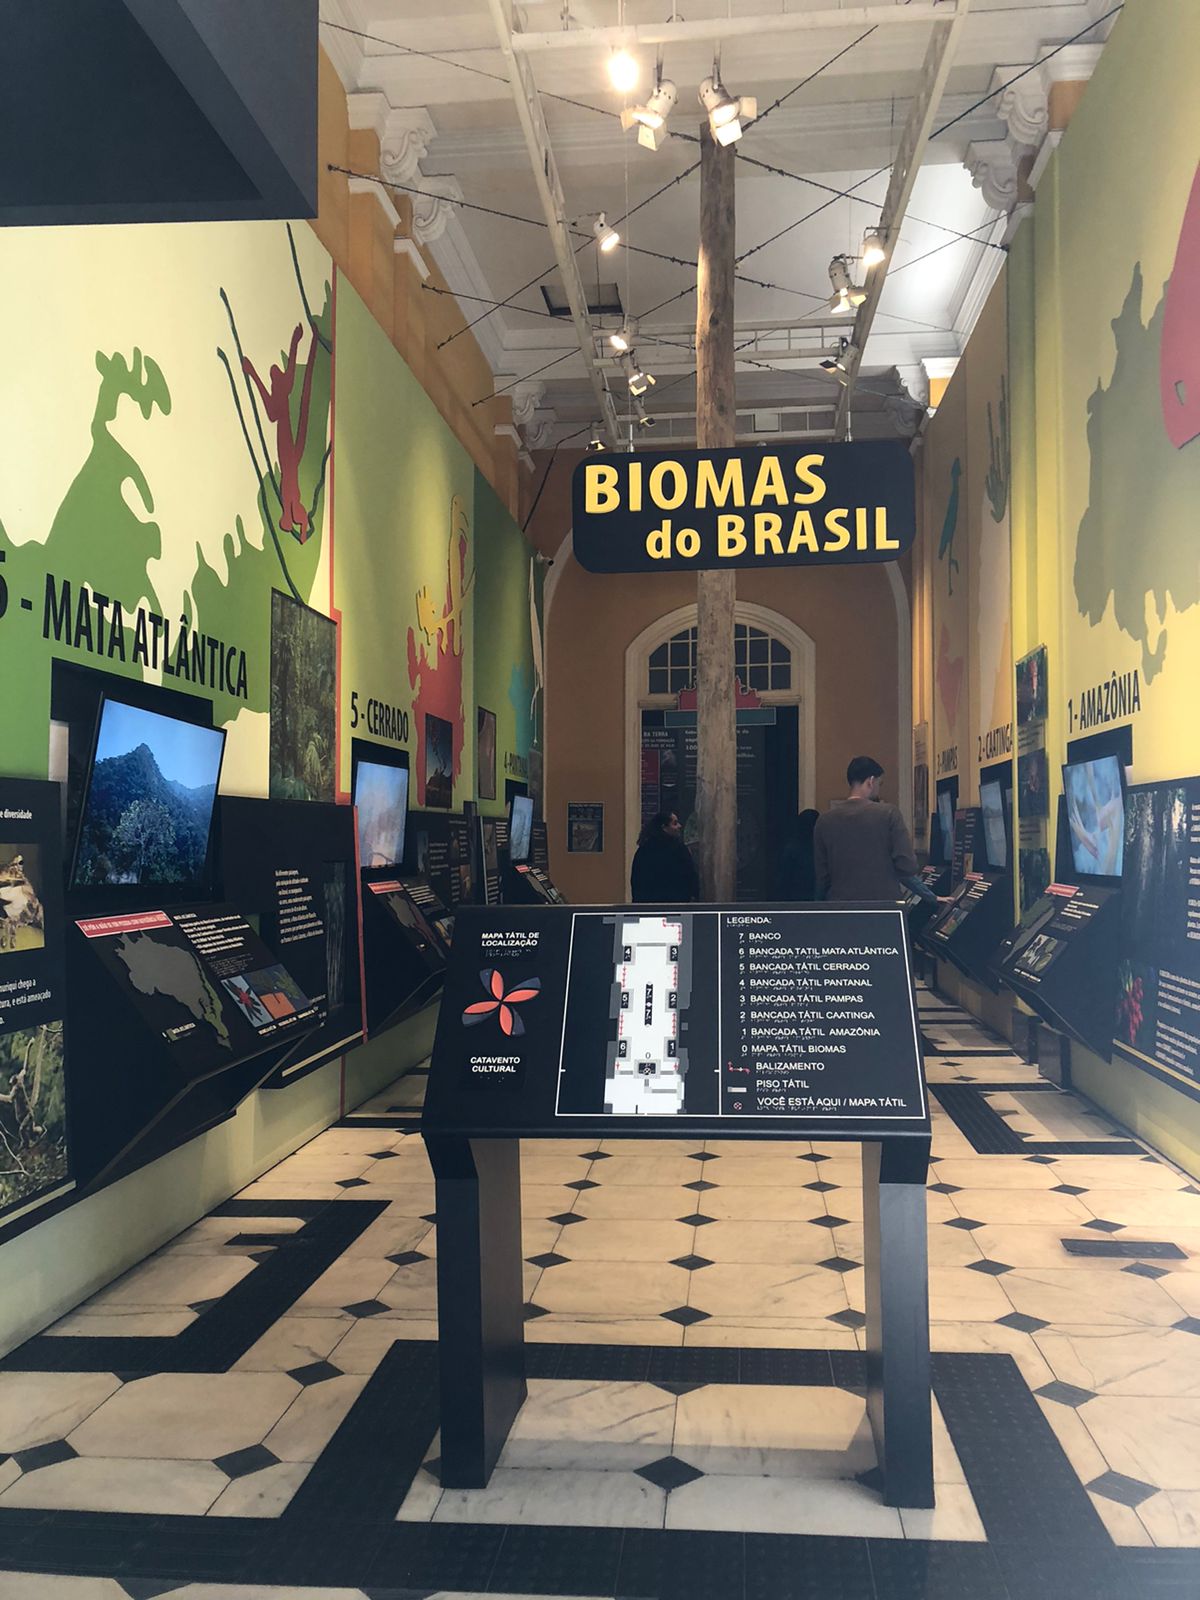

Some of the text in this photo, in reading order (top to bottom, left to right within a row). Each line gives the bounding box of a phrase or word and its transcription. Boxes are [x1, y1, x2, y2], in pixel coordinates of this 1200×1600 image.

[585, 454, 827, 513] BIOMAS
[646, 507, 900, 559] do BRASIL
[43, 573, 126, 662] MATA
[132, 607, 248, 700] ATLÂNTICA
[1080, 670, 1140, 730] AMAZÔNIA
[368, 698, 408, 743] CERRADO
[4, 809, 32, 819] diversidade
[481, 939, 537, 947] LOCALIZAÇÃO
[848, 947, 898, 955] ATLÂNTICA
[750, 963, 794, 971] BANCADA
[796, 962, 821, 970] TÁTIL
[18, 979, 32, 990] chega
[797, 978, 822, 986] TÁTIL
[16, 995, 26, 1005] está
[27, 990, 51, 1004] ameaçado
[797, 994, 822, 1002] TÁTIL
[798, 1010, 824, 1019] TÁTIL
[799, 1027, 825, 1035] TÁTIL
[829, 1027, 880, 1036] AMAZÔNIA
[780, 1044, 806, 1052] TÁTIL
[757, 1078, 809, 1088] PISO TÁTIL
[758, 1096, 785, 1106] VOCÊ
[788, 1096, 815, 1106] ESTÁ
[816, 1098, 840, 1106] AQUI
[849, 1098, 876, 1106] MAPA
[879, 1097, 906, 1106] TÁTIL
